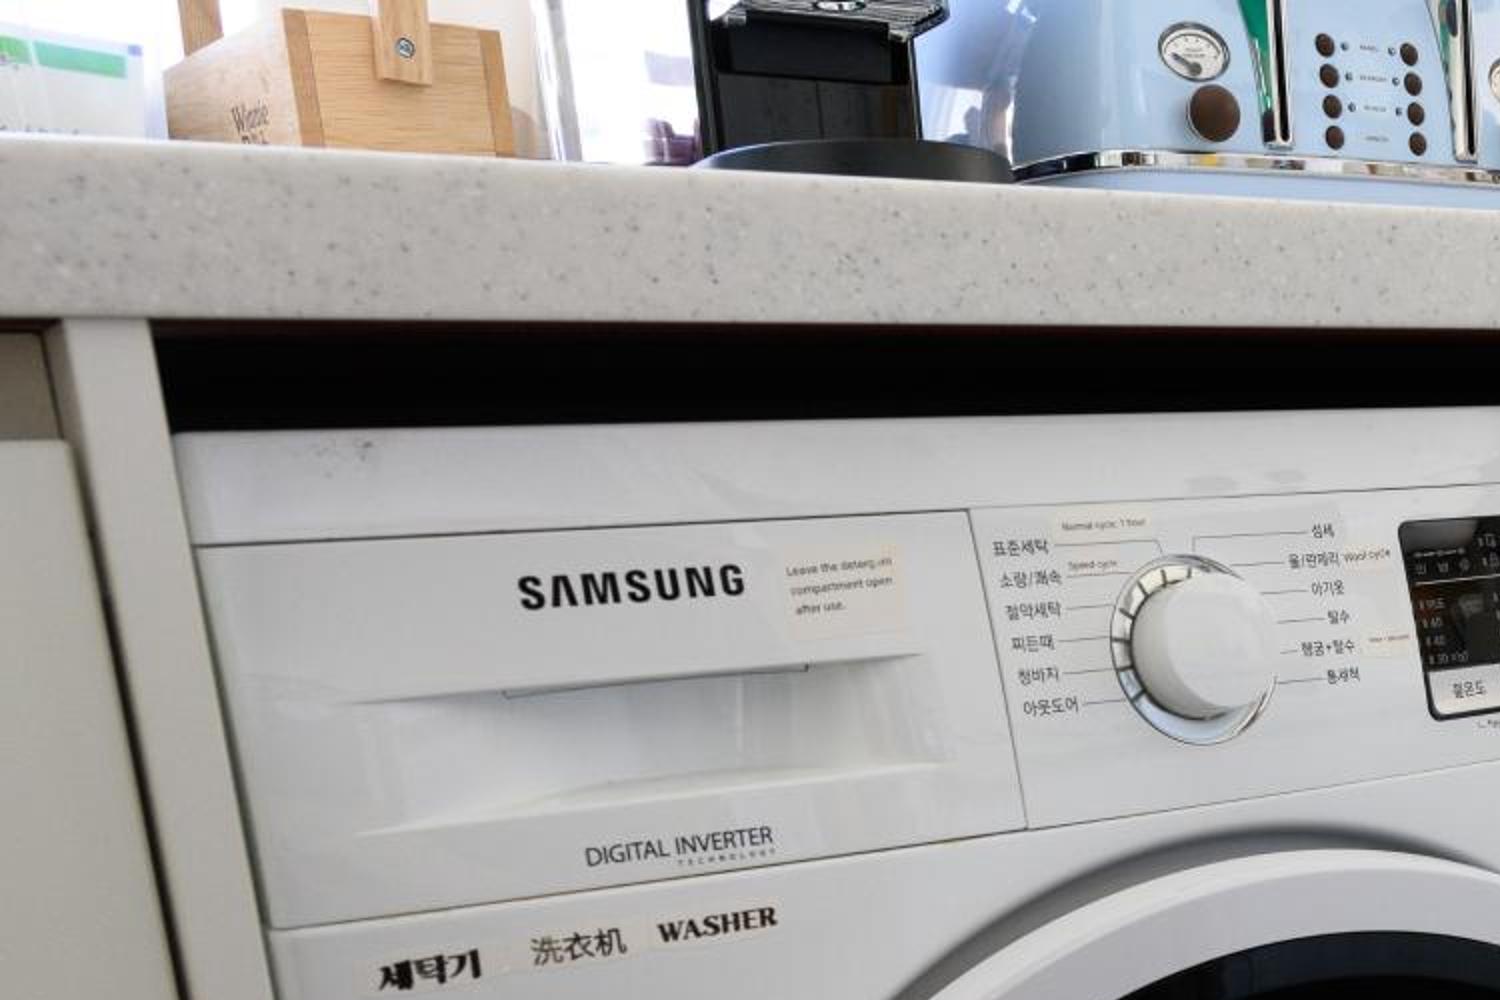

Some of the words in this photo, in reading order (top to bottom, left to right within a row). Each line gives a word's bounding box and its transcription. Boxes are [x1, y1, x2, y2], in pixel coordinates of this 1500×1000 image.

[992, 538, 1050, 557] 표준세탁
[785, 566, 819, 577] Leave
[820, 563, 838, 573] the
[517, 564, 746, 611] SAMSUNG
[789, 579, 865, 596] compartment
[866, 577, 893, 589] open
[797, 604, 821, 616] after
[1023, 696, 1079, 715] 아웃도어
[585, 837, 671, 868] DIGITAL
[674, 825, 774, 856] INVERTER
[378, 948, 483, 991] 세탁기
[530, 926, 629, 967] 洗衣机
[657, 905, 779, 944] WASHER
